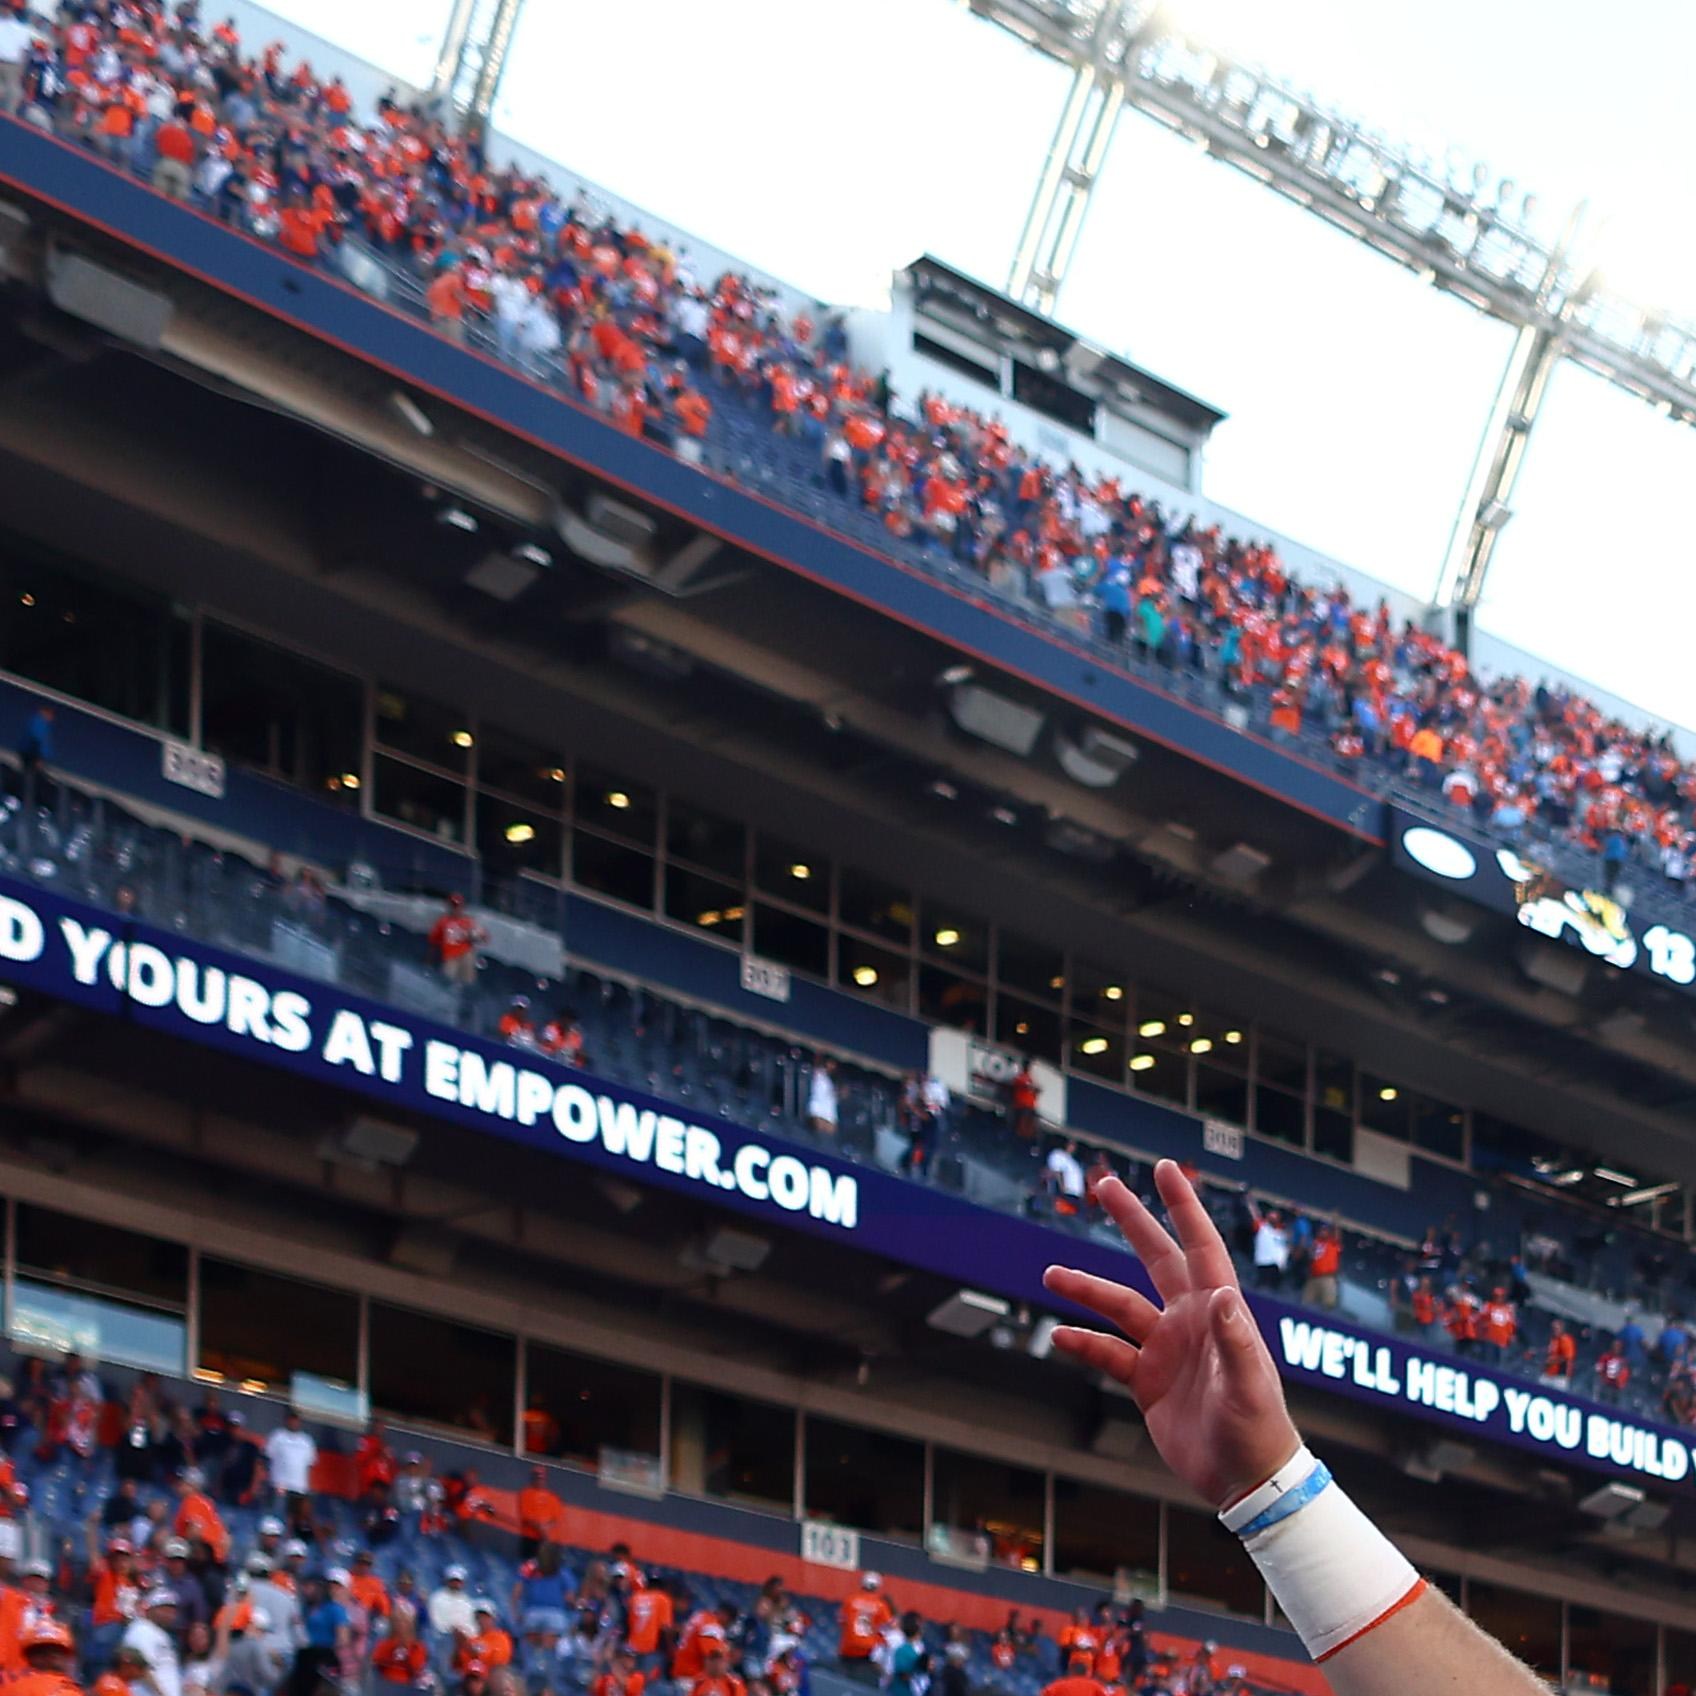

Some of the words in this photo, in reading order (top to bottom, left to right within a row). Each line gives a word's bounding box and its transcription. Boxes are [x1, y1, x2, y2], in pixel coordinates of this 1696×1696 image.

[60, 914, 312, 1053] YOURS
[323, 1010, 414, 1084] AT
[425, 1040, 860, 1228] EMPOWER.COM
[1279, 1316, 1400, 1397] WE'LL
[1406, 1357, 1499, 1423] HELP
[1503, 1388, 1584, 1449] YOU
[1588, 1415, 1688, 1482] BUILD
